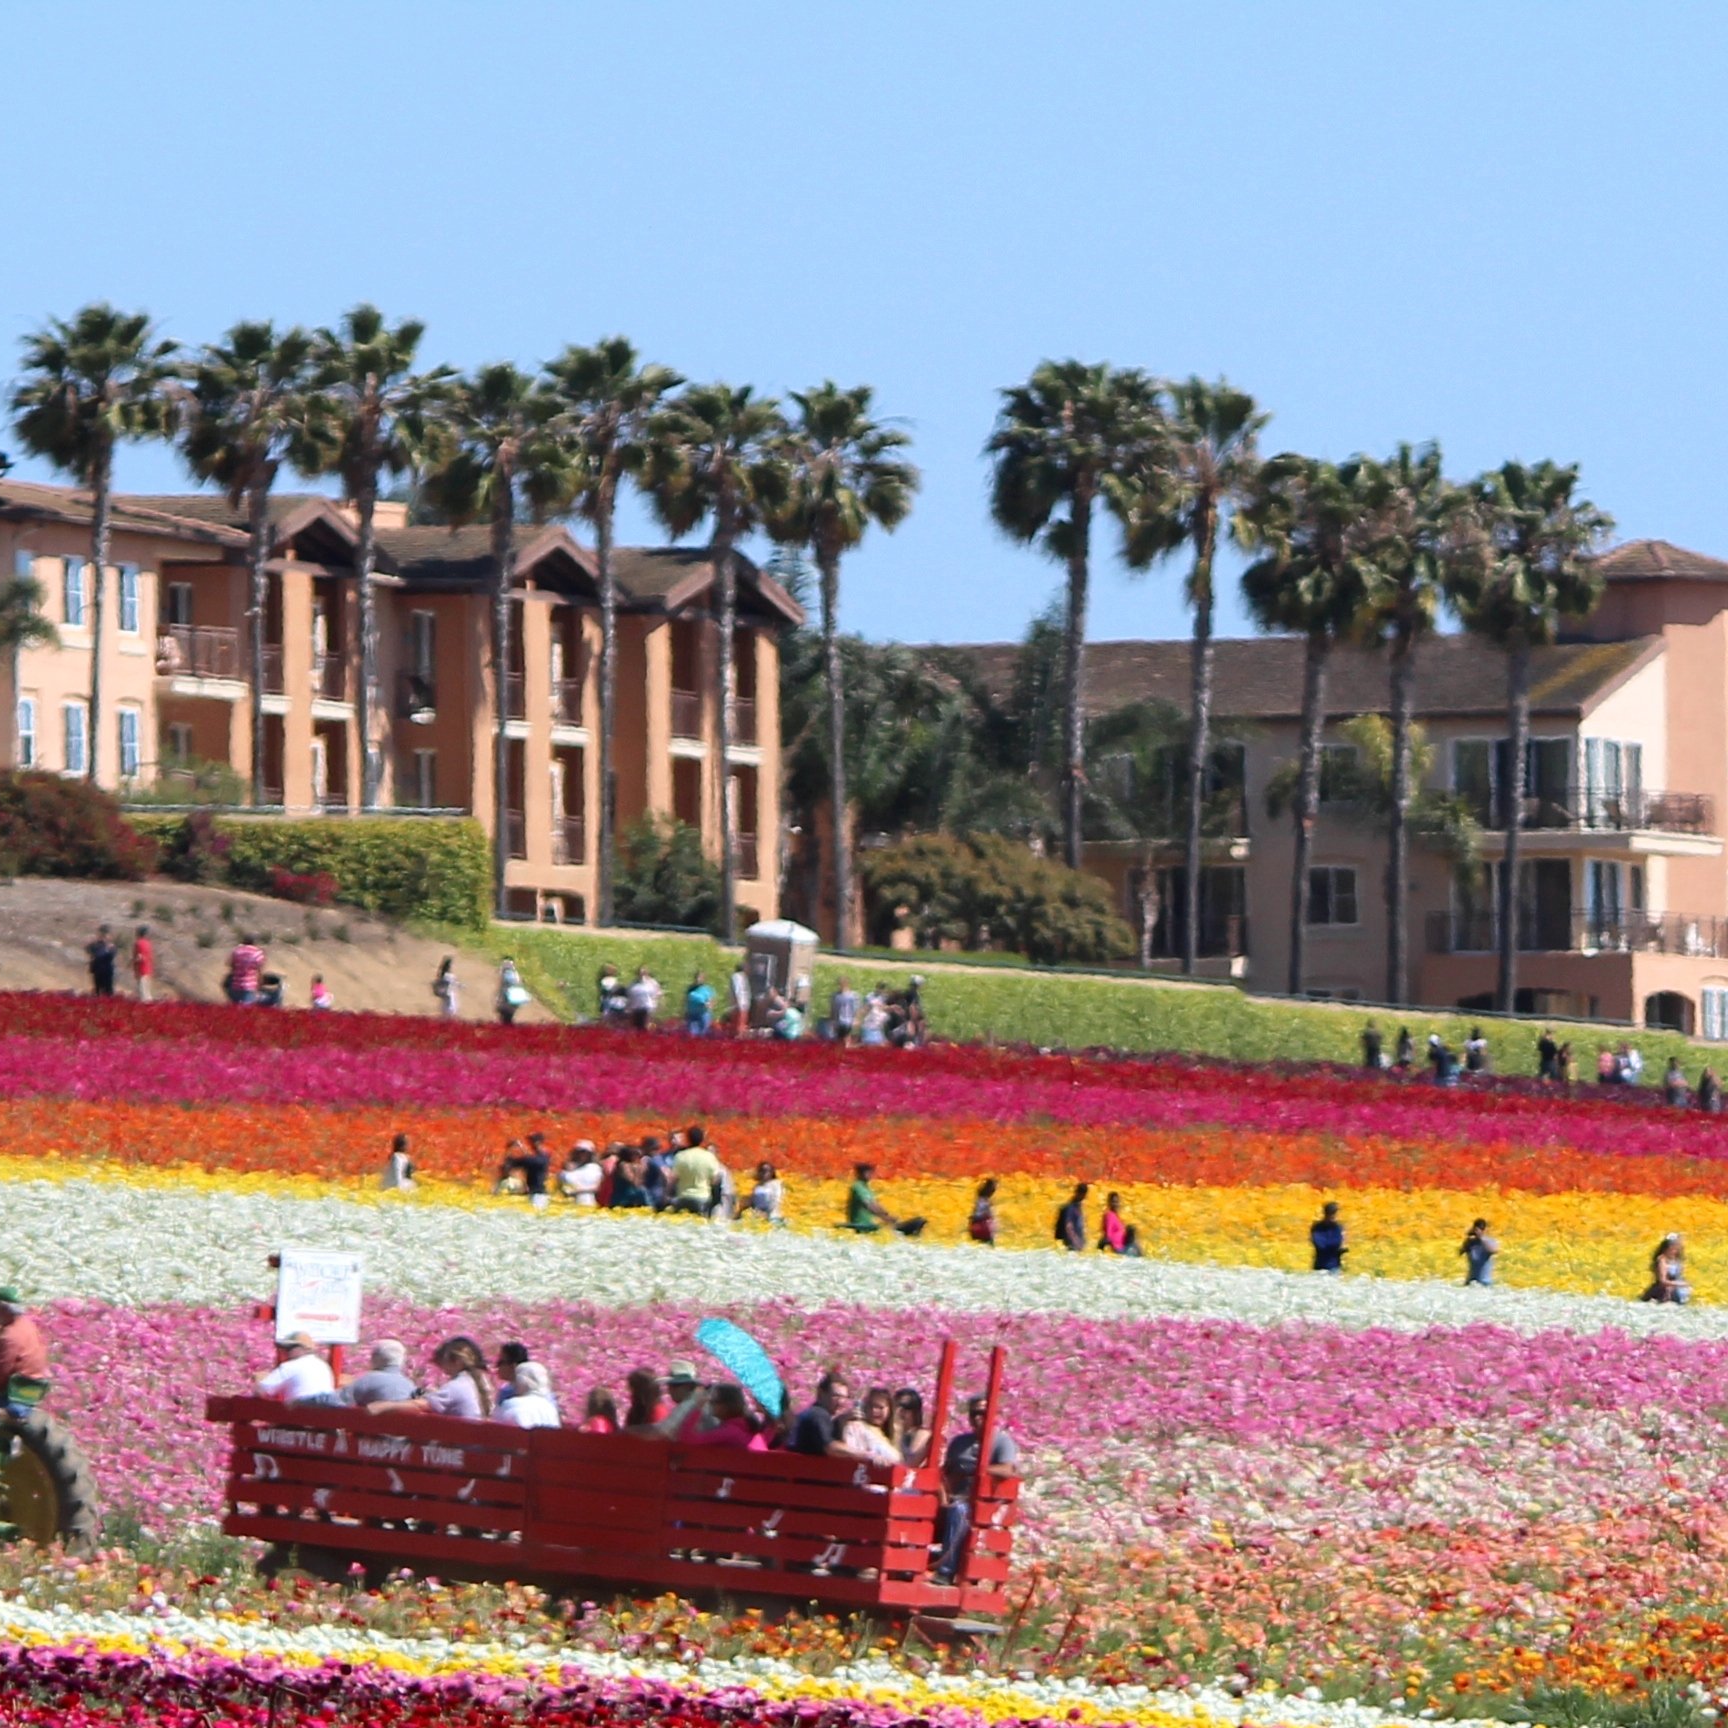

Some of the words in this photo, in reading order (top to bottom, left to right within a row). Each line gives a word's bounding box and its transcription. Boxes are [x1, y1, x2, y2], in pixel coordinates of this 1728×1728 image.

[257, 1428, 326, 1450] WHISTLE
[334, 1430, 348, 1453] A
[358, 1438, 412, 1462] HAPPY
[421, 1444, 465, 1467] TUNE
